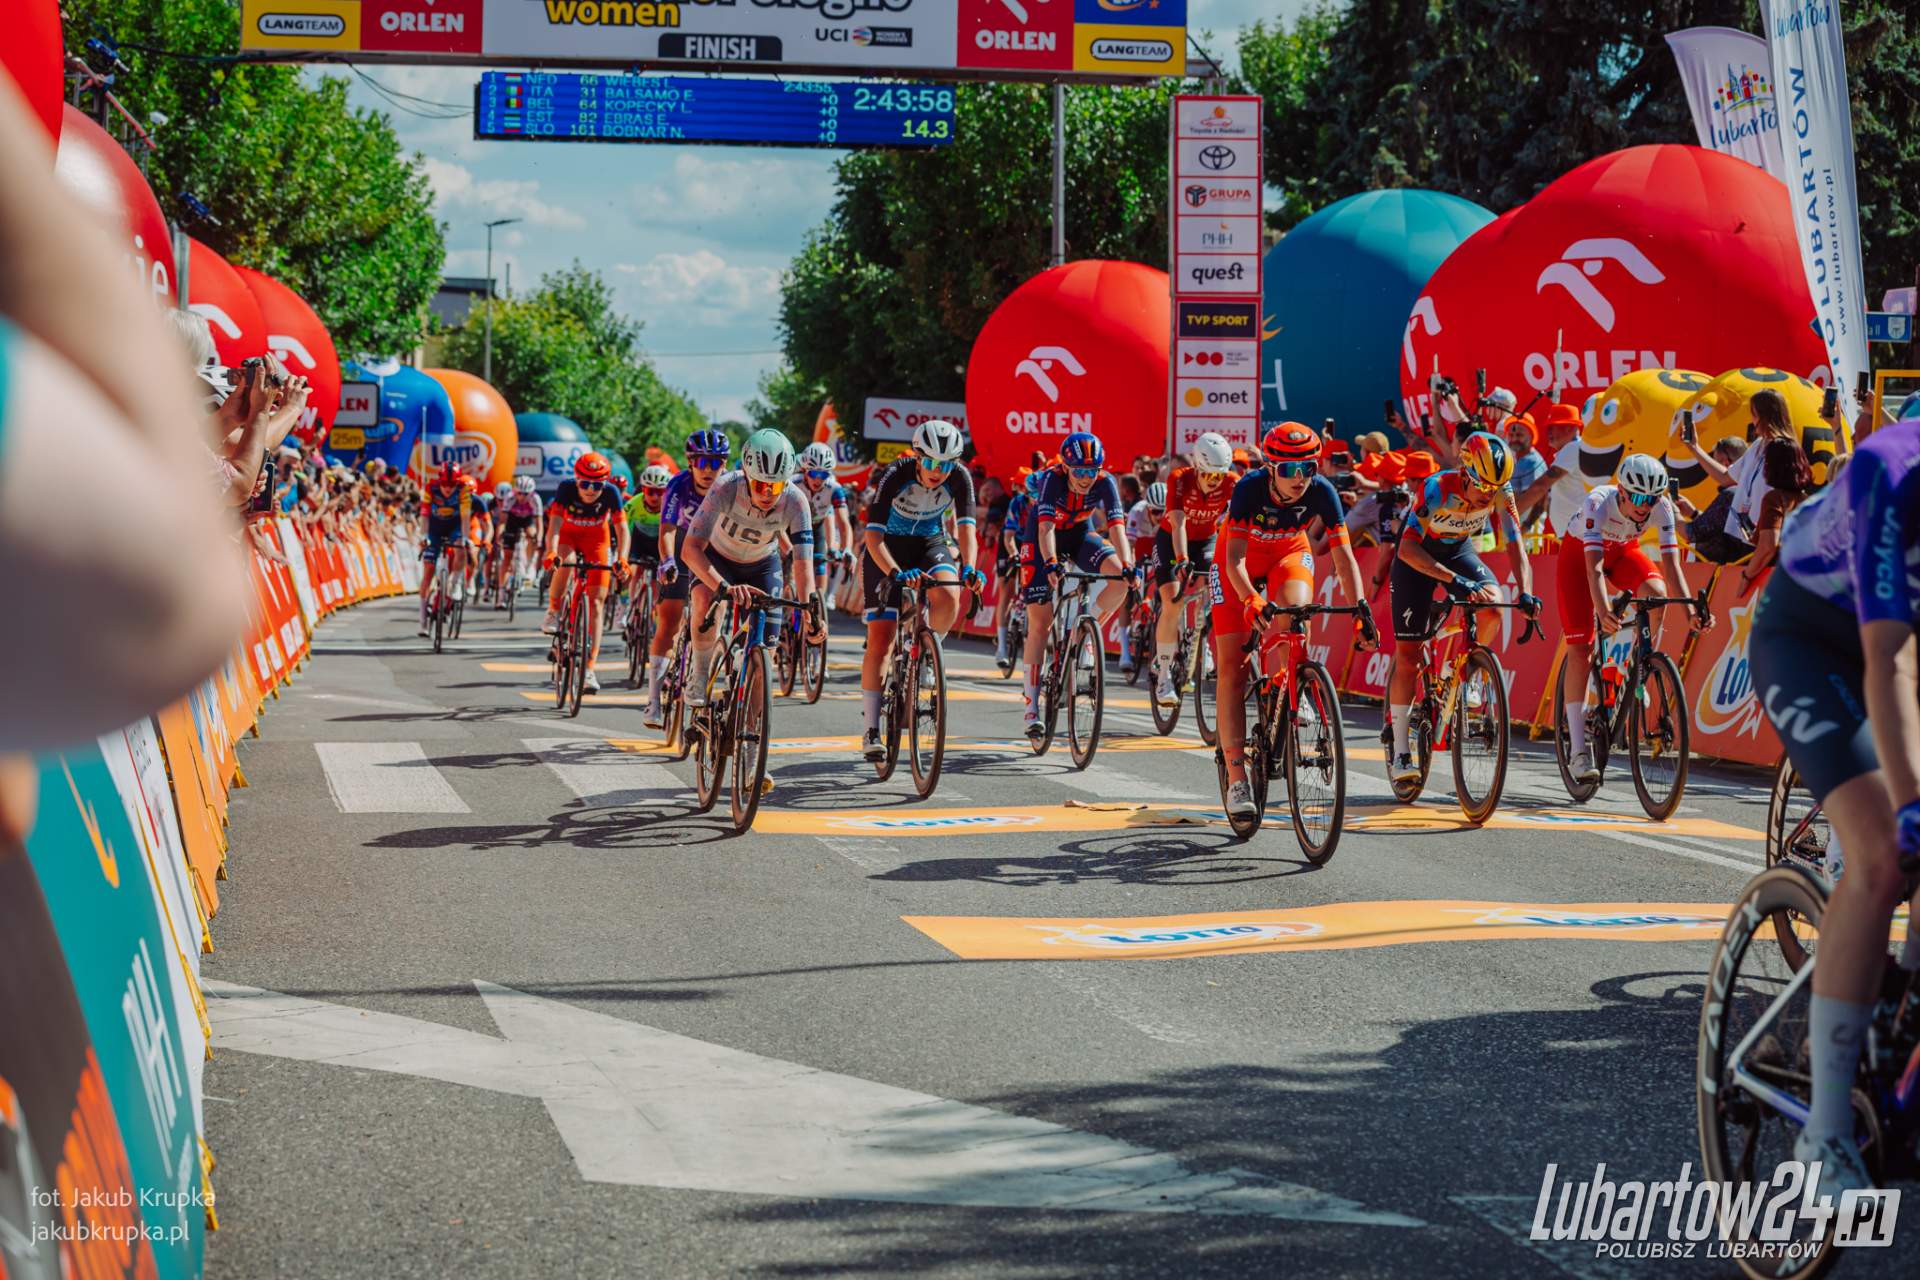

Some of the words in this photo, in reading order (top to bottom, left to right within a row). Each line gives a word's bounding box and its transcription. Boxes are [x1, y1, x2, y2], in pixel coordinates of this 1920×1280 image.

[264, 18, 340, 33] LANGTEAM
[380, 11, 465, 33] ORLEN
[815, 28, 848, 42] UCI
[975, 30, 1056, 52] ORLEN
[685, 36, 757, 60] FINISH
[1097, 45, 1167, 56] LANGTEAM
[580, 87, 597, 98] 31
[605, 88, 681, 101] BALSAMO
[820, 94, 838, 106] +0
[853, 88, 953, 113] 2:43:58
[527, 98, 555, 109] BEL
[604, 100, 677, 113] KOPECKY
[819, 107, 838, 117] +0
[527, 111, 554, 122] EST
[819, 119, 838, 130] +0
[902, 120, 949, 138] 14.3
[526, 124, 555, 135] SLO
[570, 124, 597, 136] 161
[818, 131, 837, 143] +0
[1209, 188, 1251, 199] GRUPA
[1202, 232, 1233, 245] PHH
[1823, 168, 1847, 336] www.lubartow.pl
[1192, 262, 1244, 285] quest
[1187, 315, 1209, 325] TVP
[1212, 315, 1249, 326] SPORT
[1207, 390, 1248, 404] onet
[1005, 411, 1092, 434] ORLEN
[1765, 684, 1840, 744] Liv
[1101, 926, 1263, 944] LOTTO
